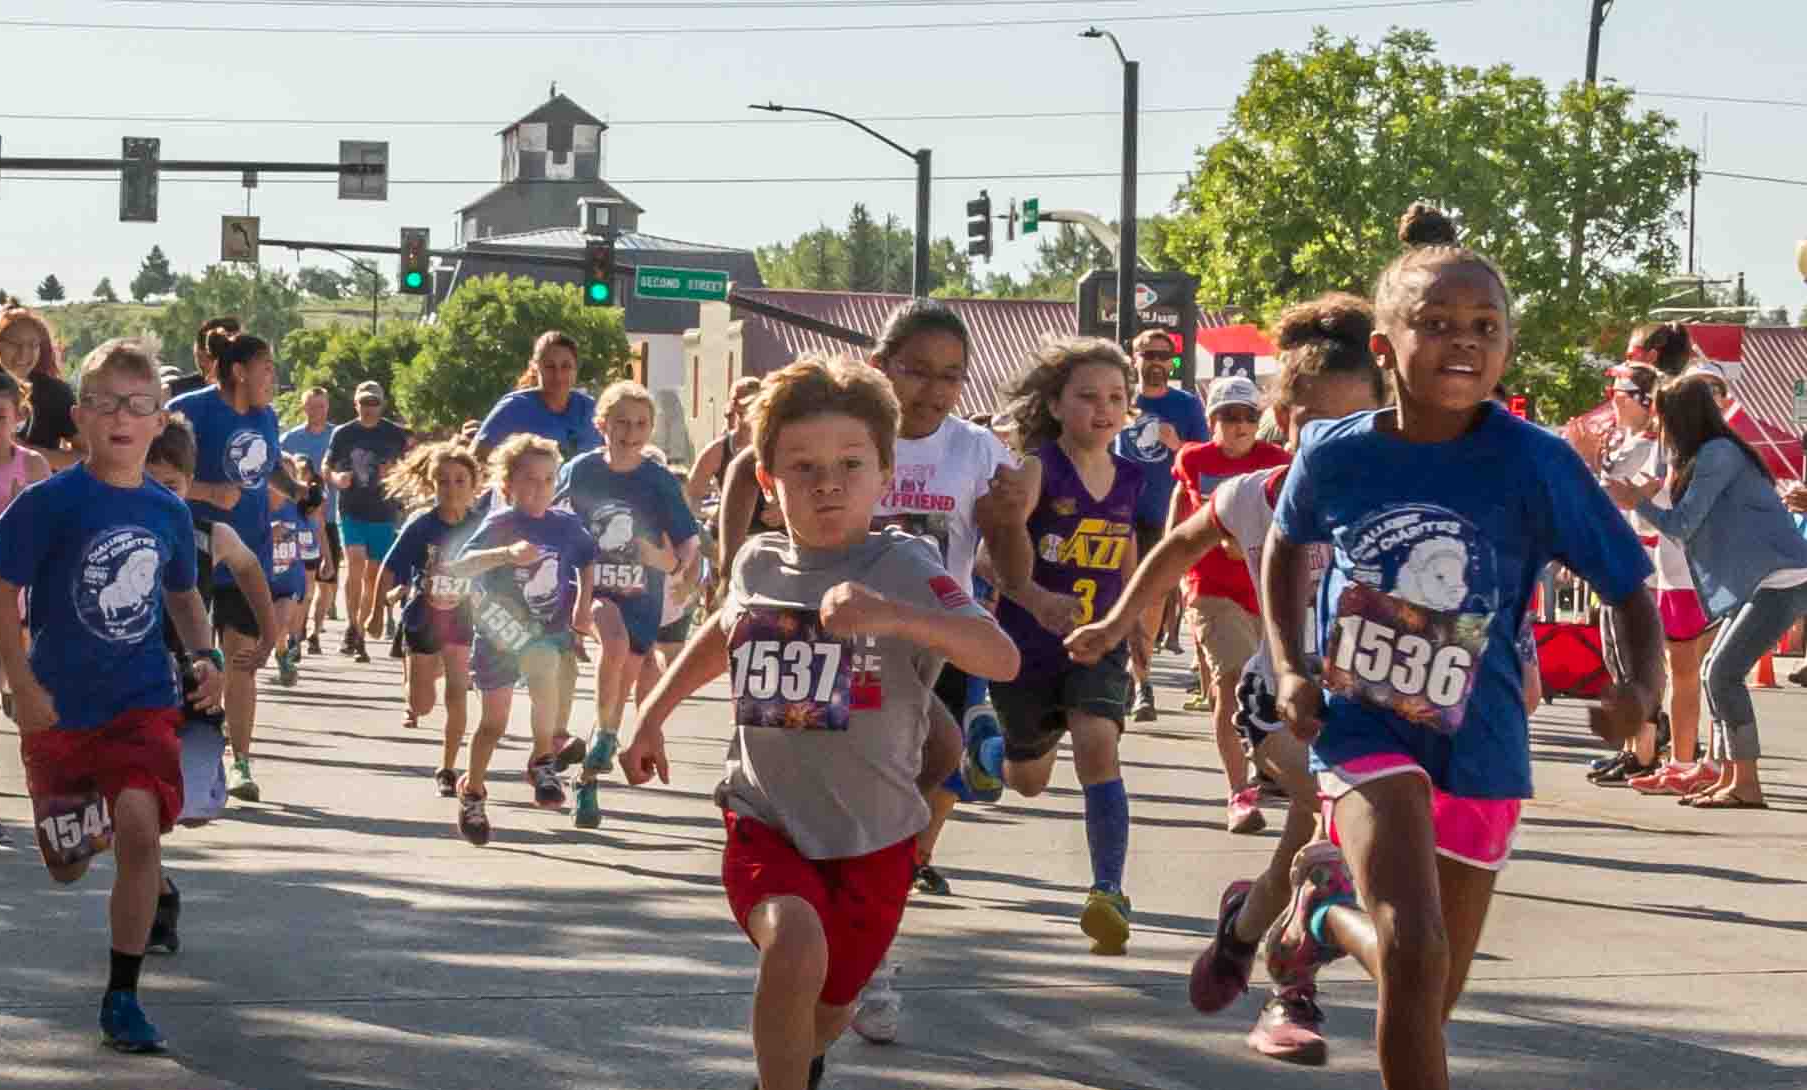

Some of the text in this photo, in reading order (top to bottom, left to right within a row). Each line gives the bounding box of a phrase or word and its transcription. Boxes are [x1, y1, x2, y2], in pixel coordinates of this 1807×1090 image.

[640, 275, 724, 293] SECOND STREET
[1072, 577, 1098, 626] 3
[732, 640, 841, 702] 1537
[1335, 614, 1472, 707] 1536
